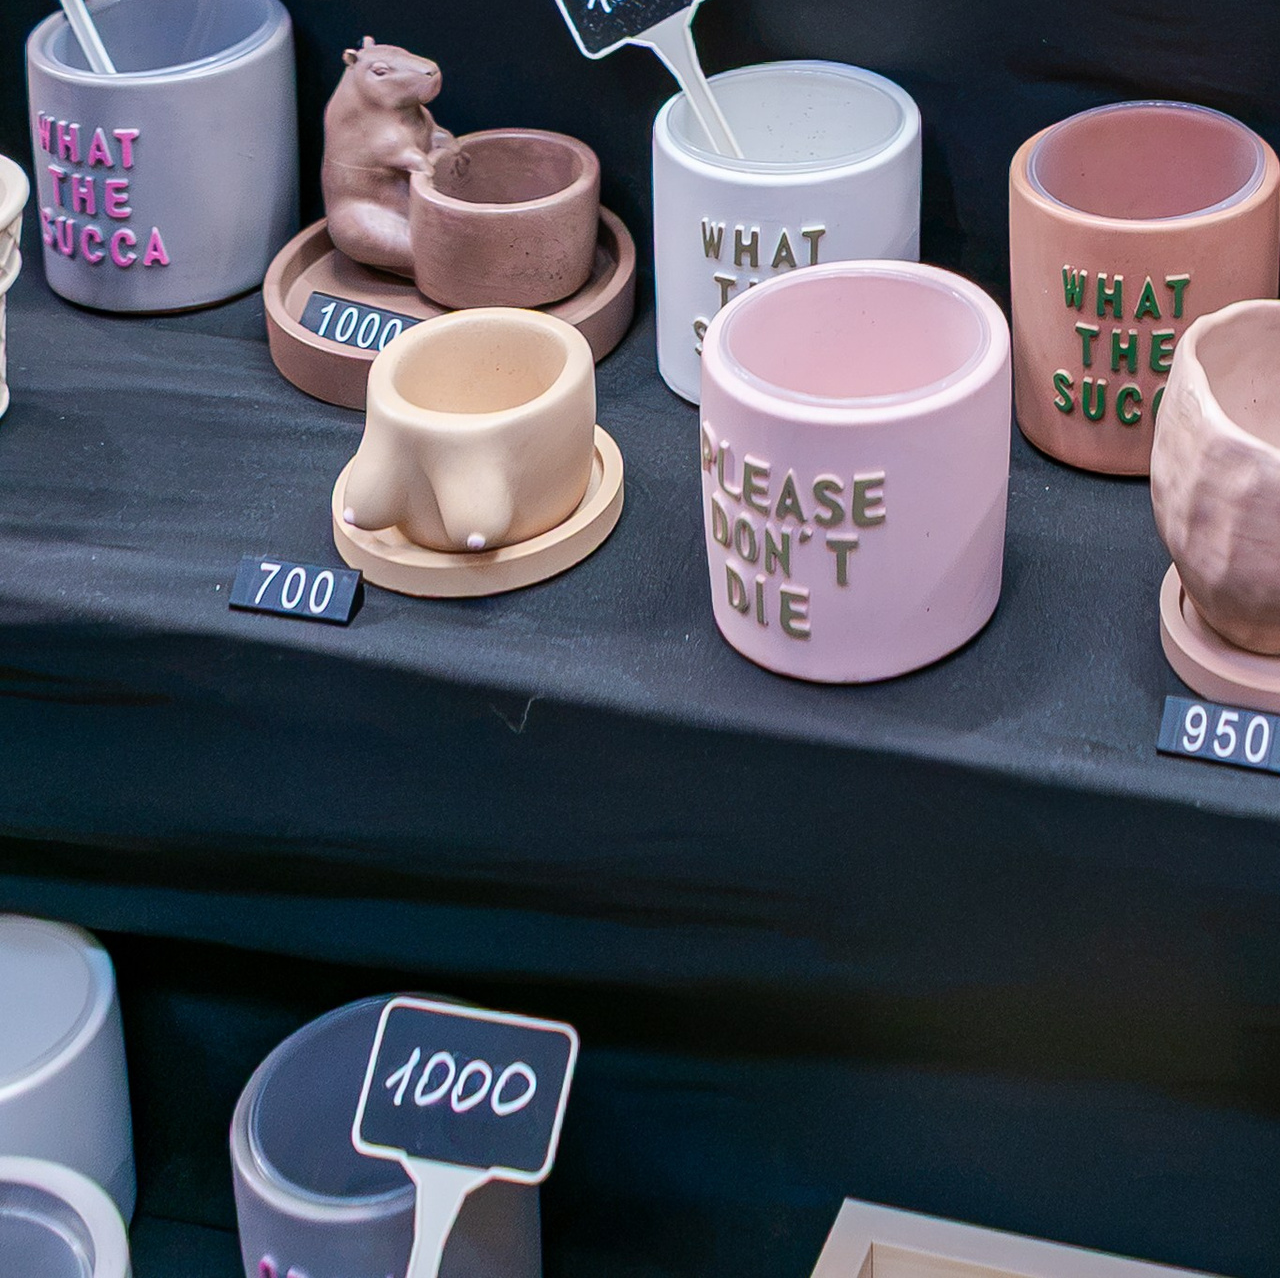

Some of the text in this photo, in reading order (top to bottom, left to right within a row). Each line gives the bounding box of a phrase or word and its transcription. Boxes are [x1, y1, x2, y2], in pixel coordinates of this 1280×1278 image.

[37, 110, 141, 169] WHAT
[47, 164, 134, 219] THE
[40, 207, 172, 269] SUCCA
[701, 217, 827, 268] WHAT
[1062, 264, 1191, 320] WHAT
[317, 301, 403, 353] 1000
[1075, 321, 1176, 375] THE
[1053, 369, 1167, 426] SUC
[701, 421, 887, 529] PLEASE
[257, 561, 336, 616] 700
[726, 560, 813, 640] DIE
[1180, 704, 1271, 764] 950
[385, 1046, 537, 1116] 1000
